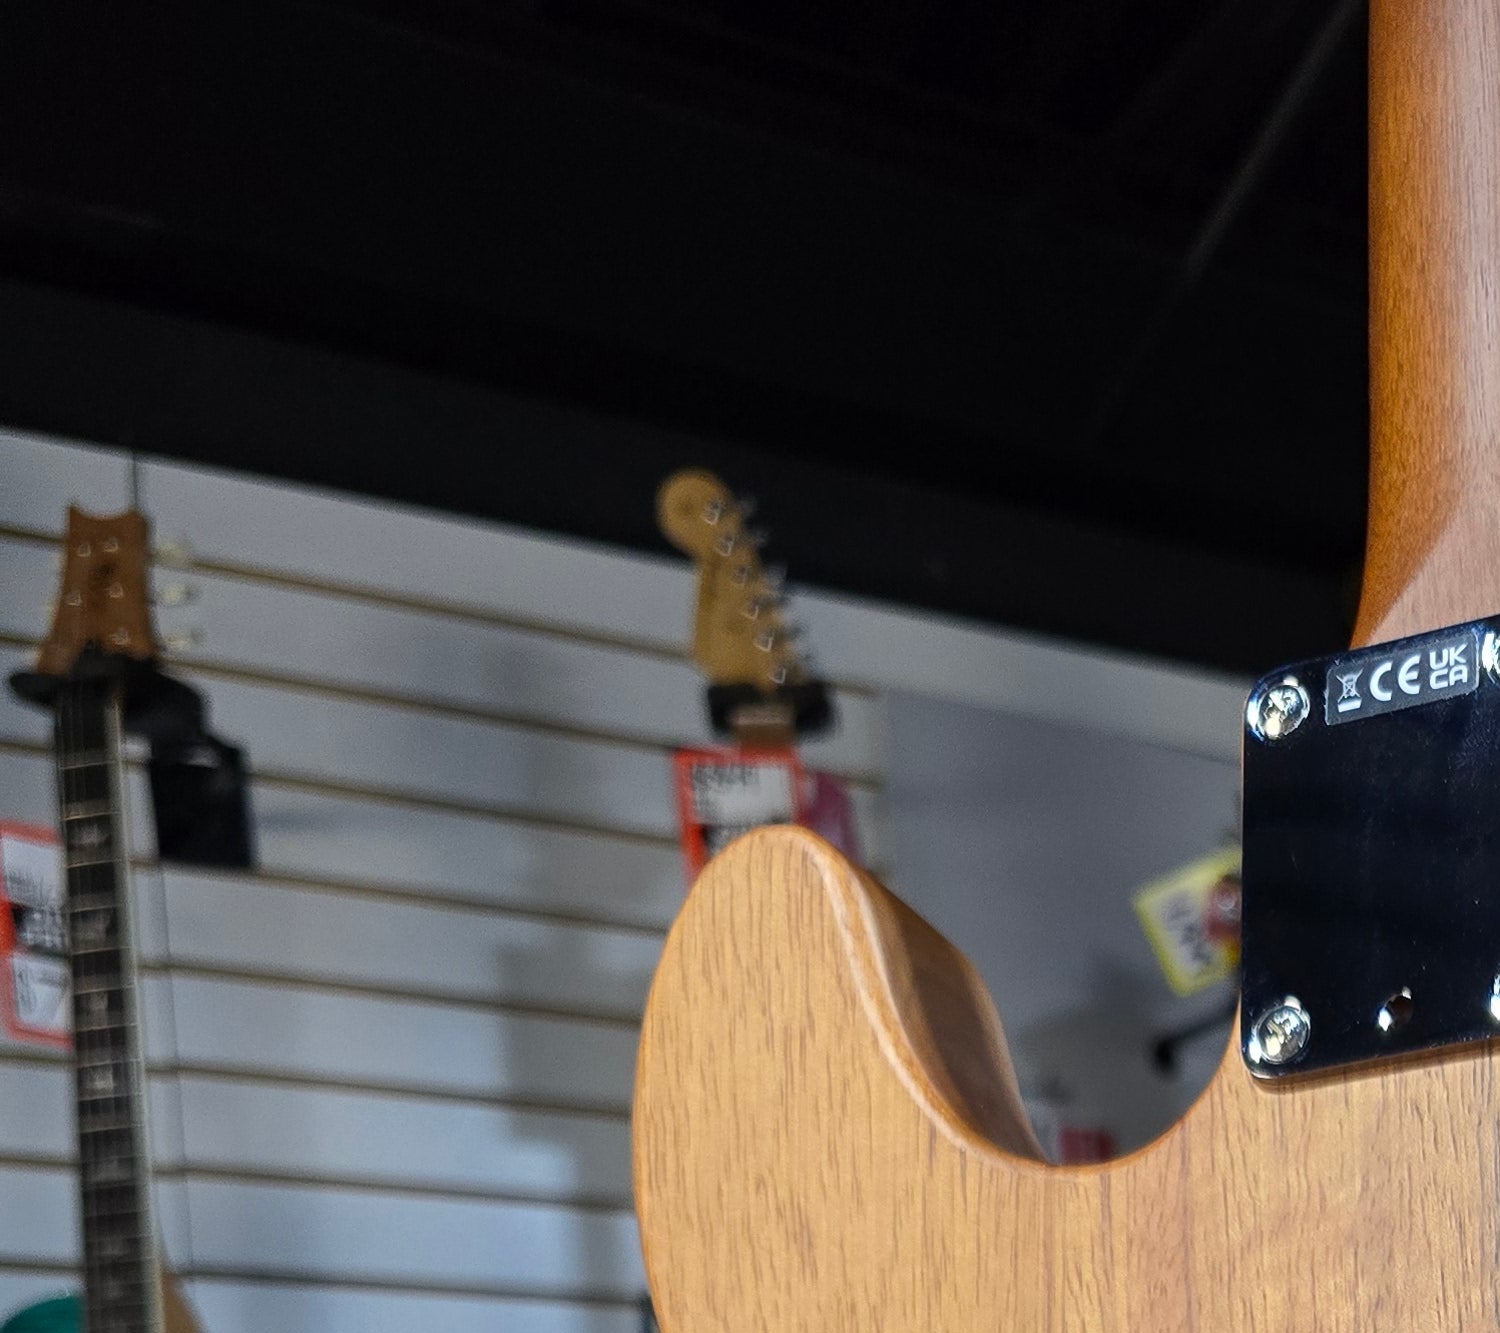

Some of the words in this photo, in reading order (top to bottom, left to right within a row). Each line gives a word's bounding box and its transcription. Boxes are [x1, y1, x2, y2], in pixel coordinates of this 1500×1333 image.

[1429, 643, 1468, 671] UK
[1369, 654, 1421, 702] CE
[1429, 664, 1469, 690] CA
